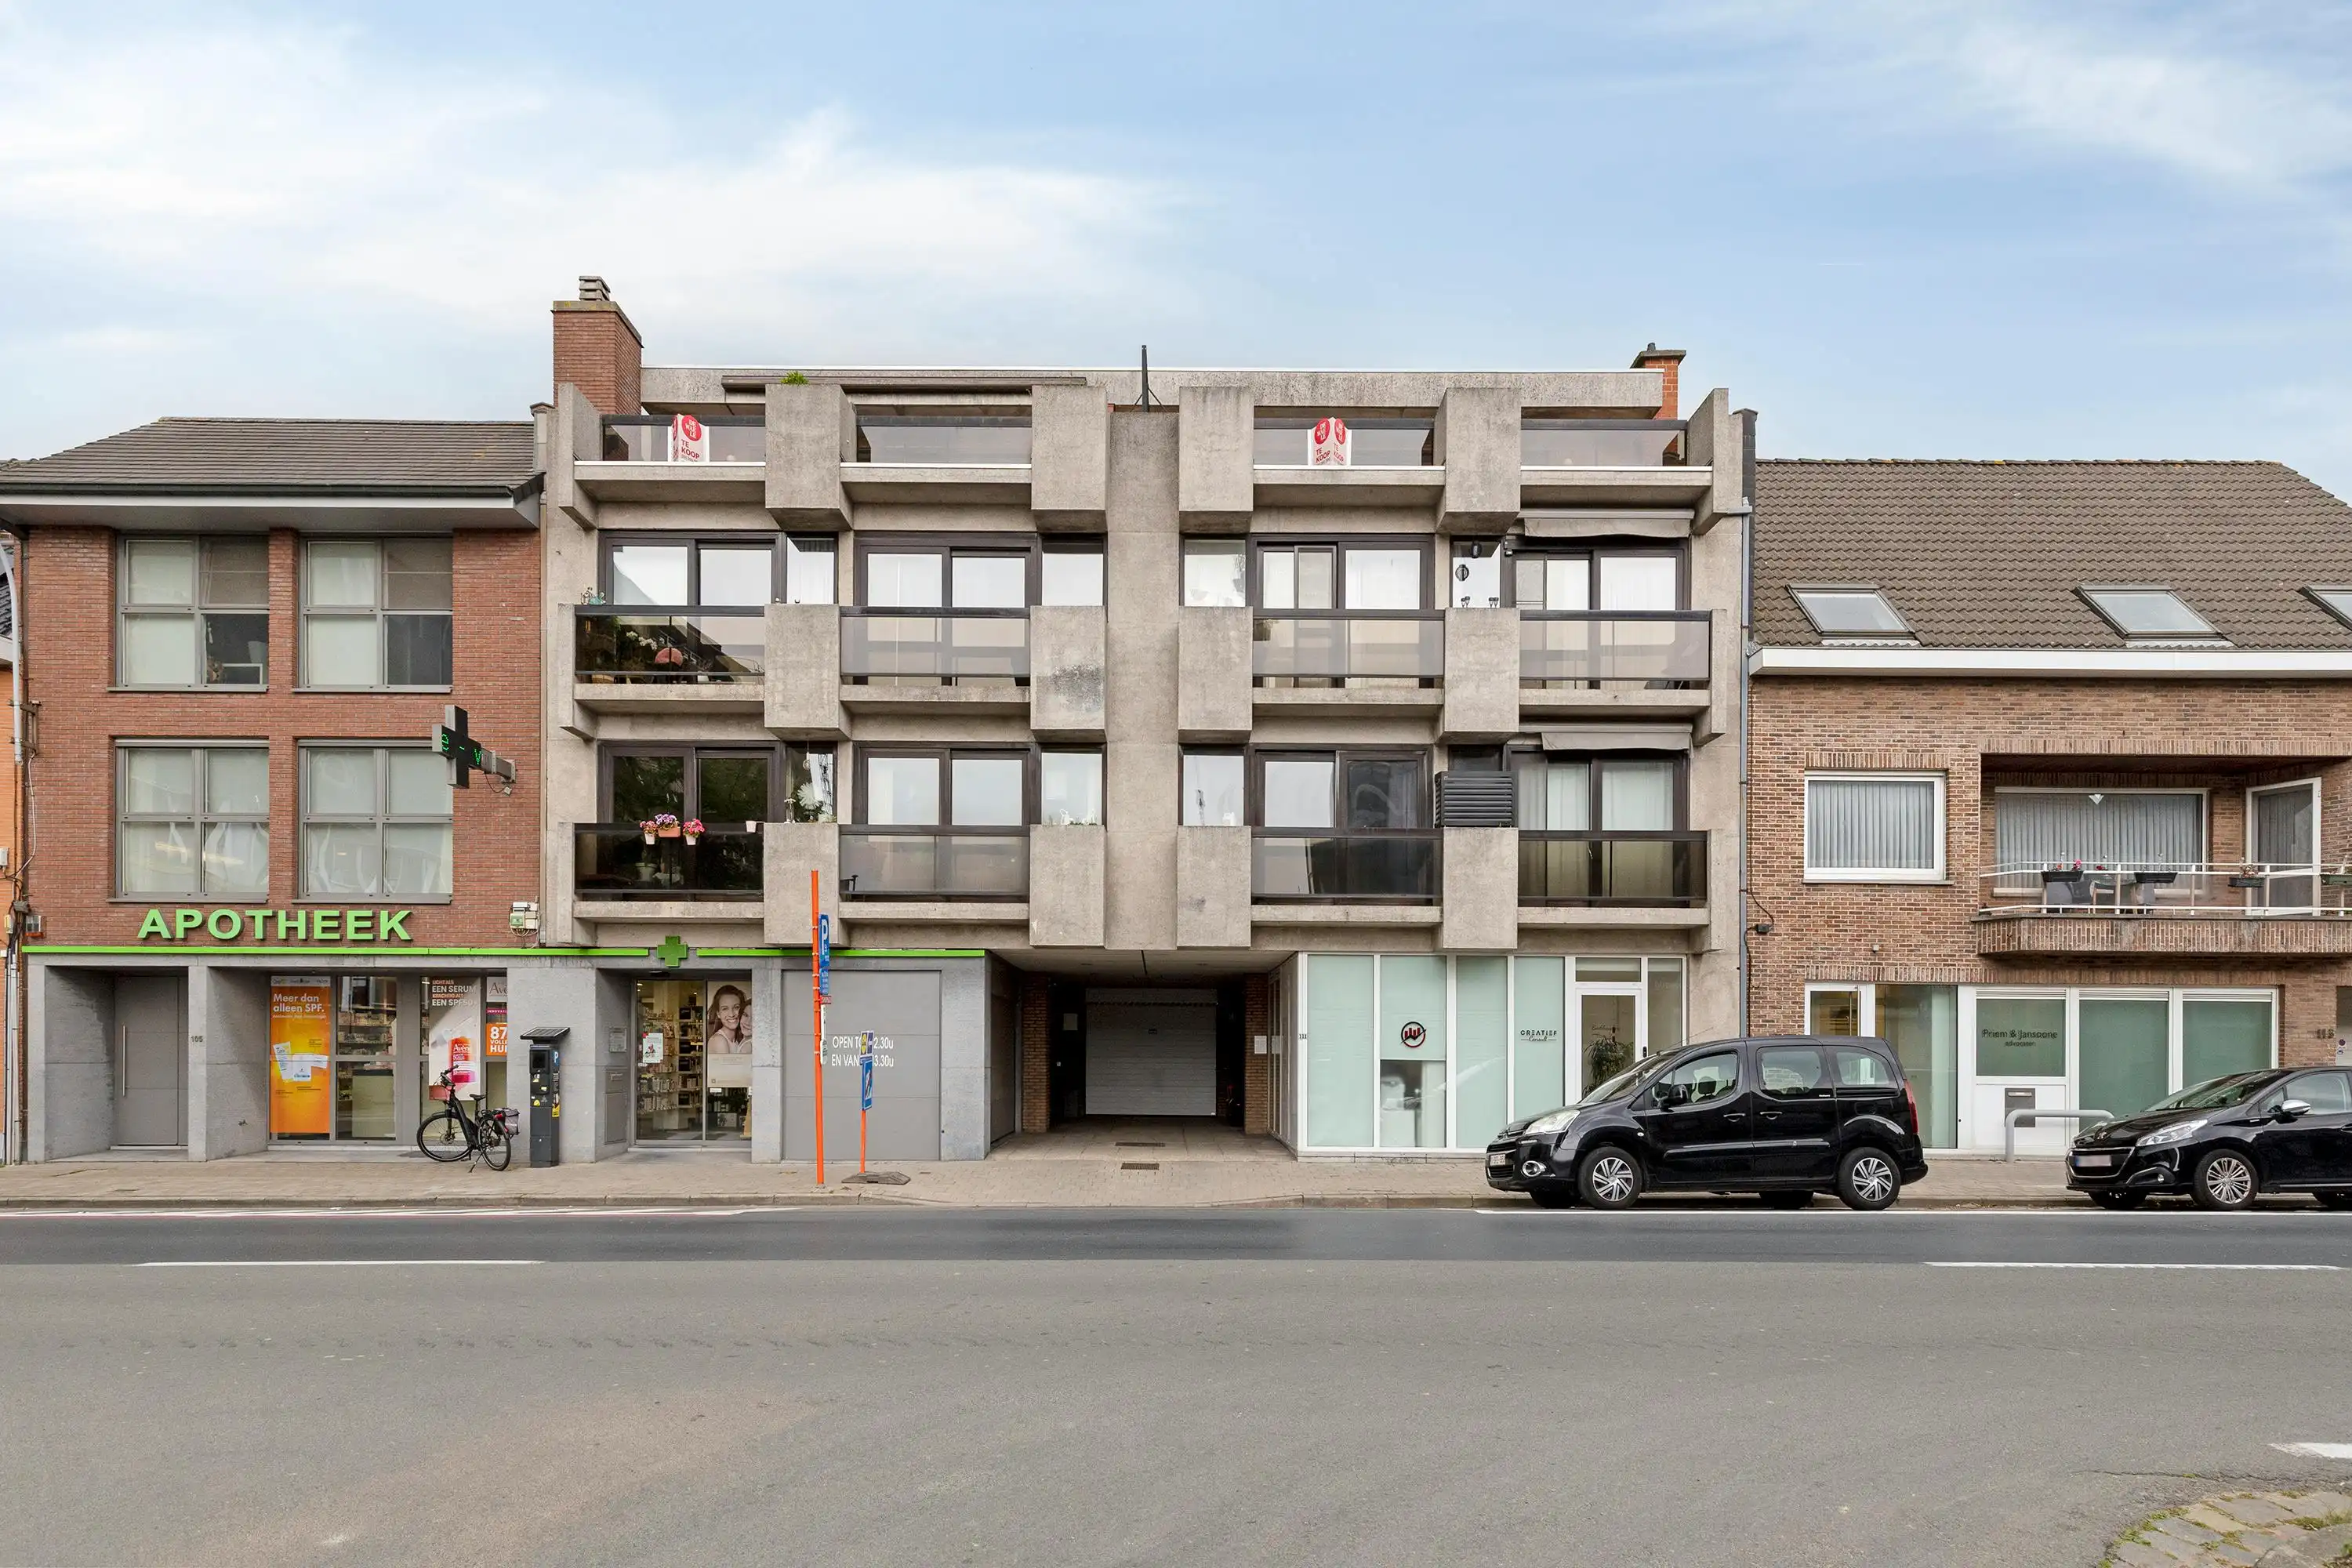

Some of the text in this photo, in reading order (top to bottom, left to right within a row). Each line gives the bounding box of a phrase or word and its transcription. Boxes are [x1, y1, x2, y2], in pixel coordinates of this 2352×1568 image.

[681, 439, 689, 448] TE
[681, 447, 699, 459] KOOP
[1316, 447, 1323, 456] TE
[1316, 450, 1330, 463] KOOP
[137, 909, 412, 940] APOTHEEK
[821, 919, 828, 955] P
[448, 985, 477, 994] SERUM
[273, 993, 319, 1003] Meer dan
[273, 1003, 325, 1012] alleen SPF.
[1982, 1029, 2008, 1038] Priem
[2009, 1029, 2016, 1038] &
[832, 1036, 853, 1048] OPEN
[873, 1036, 894, 1049] 2.30u
[831, 1054, 841, 1066] EN
